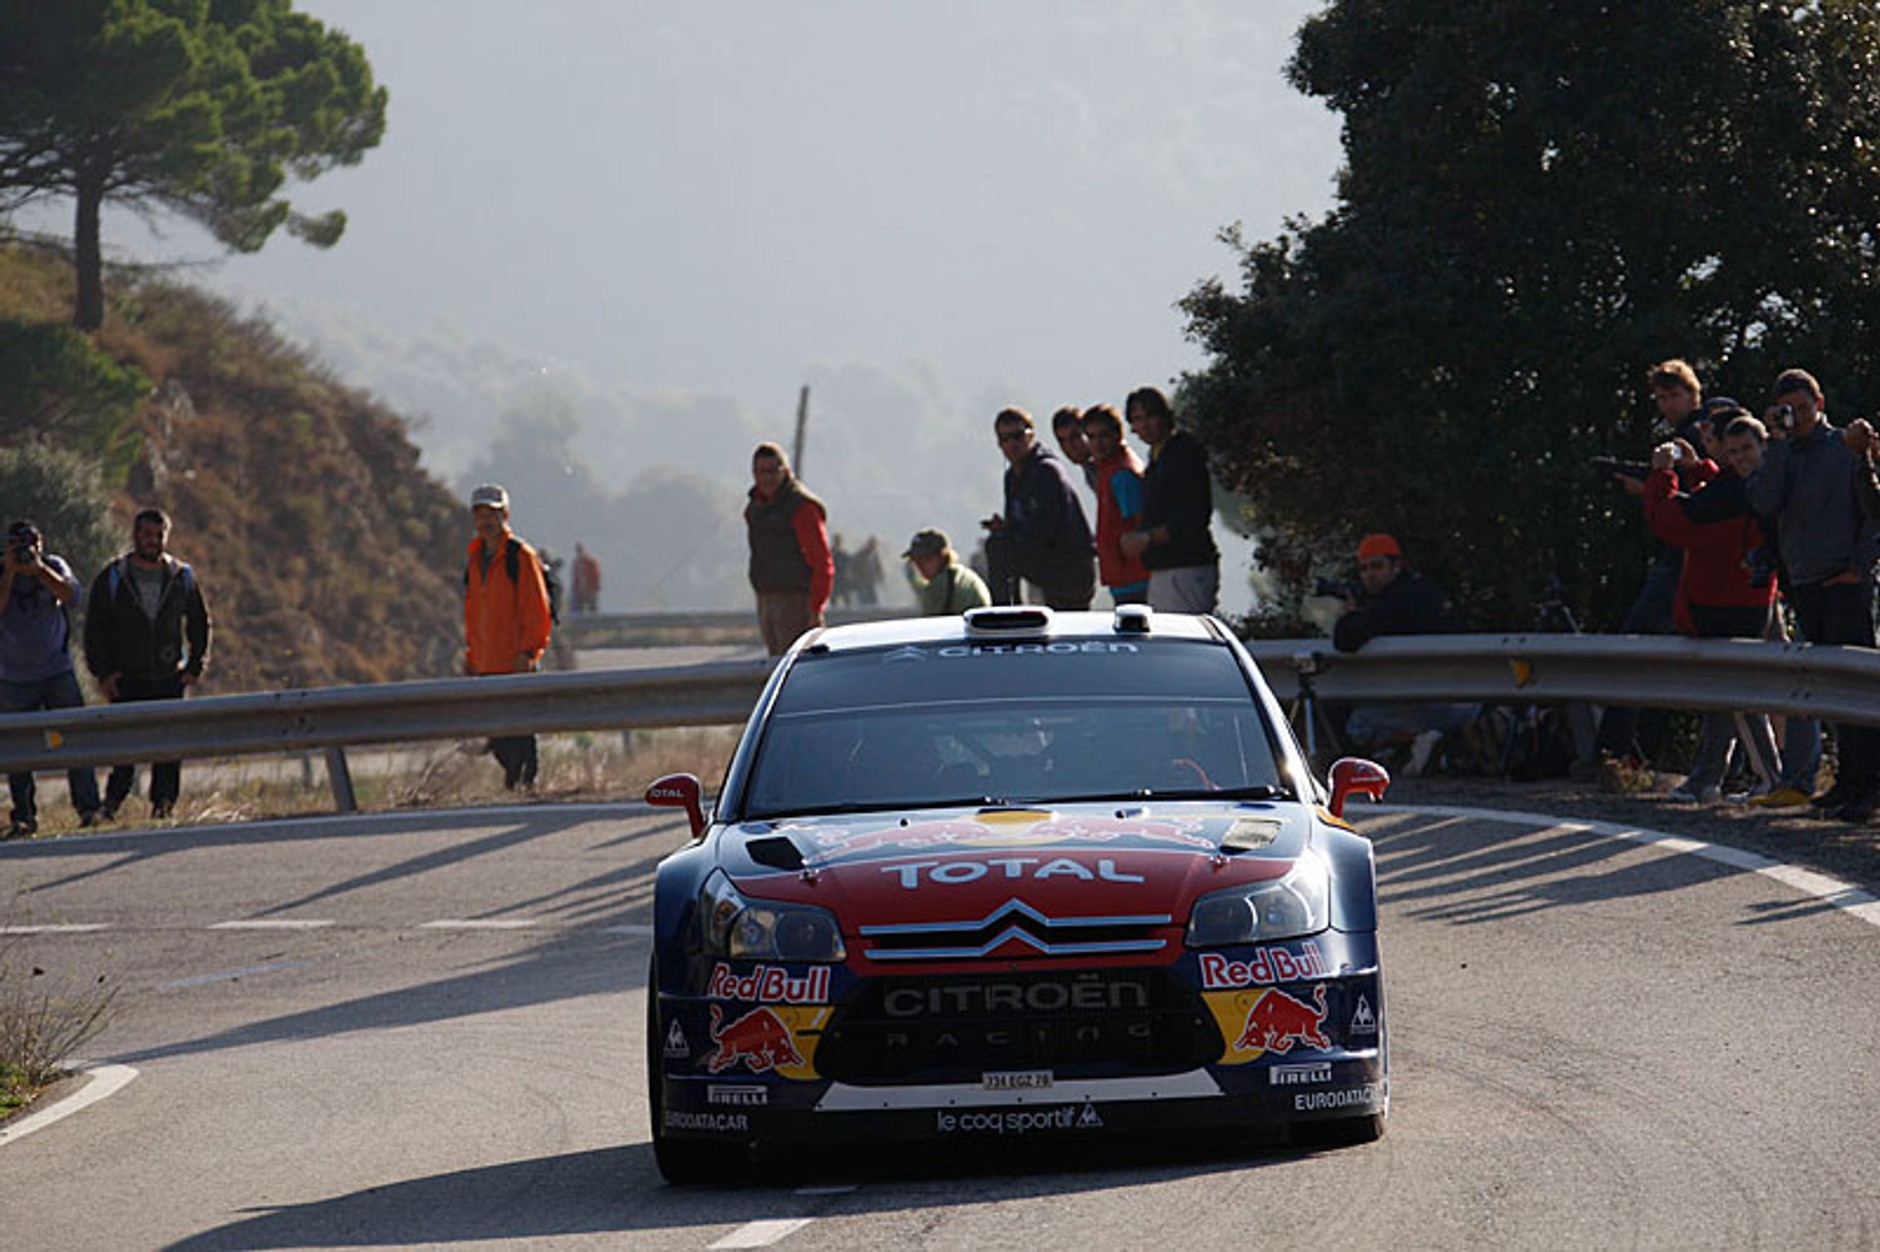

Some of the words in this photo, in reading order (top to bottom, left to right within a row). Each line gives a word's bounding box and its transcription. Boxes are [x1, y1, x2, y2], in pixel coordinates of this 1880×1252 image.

[881, 858, 1146, 889] TOTAL
[1200, 947, 1275, 987] Red
[1270, 940, 1326, 982] Bull
[706, 962, 765, 1000] Red
[760, 965, 831, 1003] Bull
[885, 1023, 1151, 1047] RACING
[1270, 1062, 1331, 1085] PIRELLI
[708, 1085, 767, 1104] PIRELLI
[938, 1110, 955, 1130] le
[960, 1110, 1003, 1134] coq
[1006, 1106, 1075, 1133] sportif
